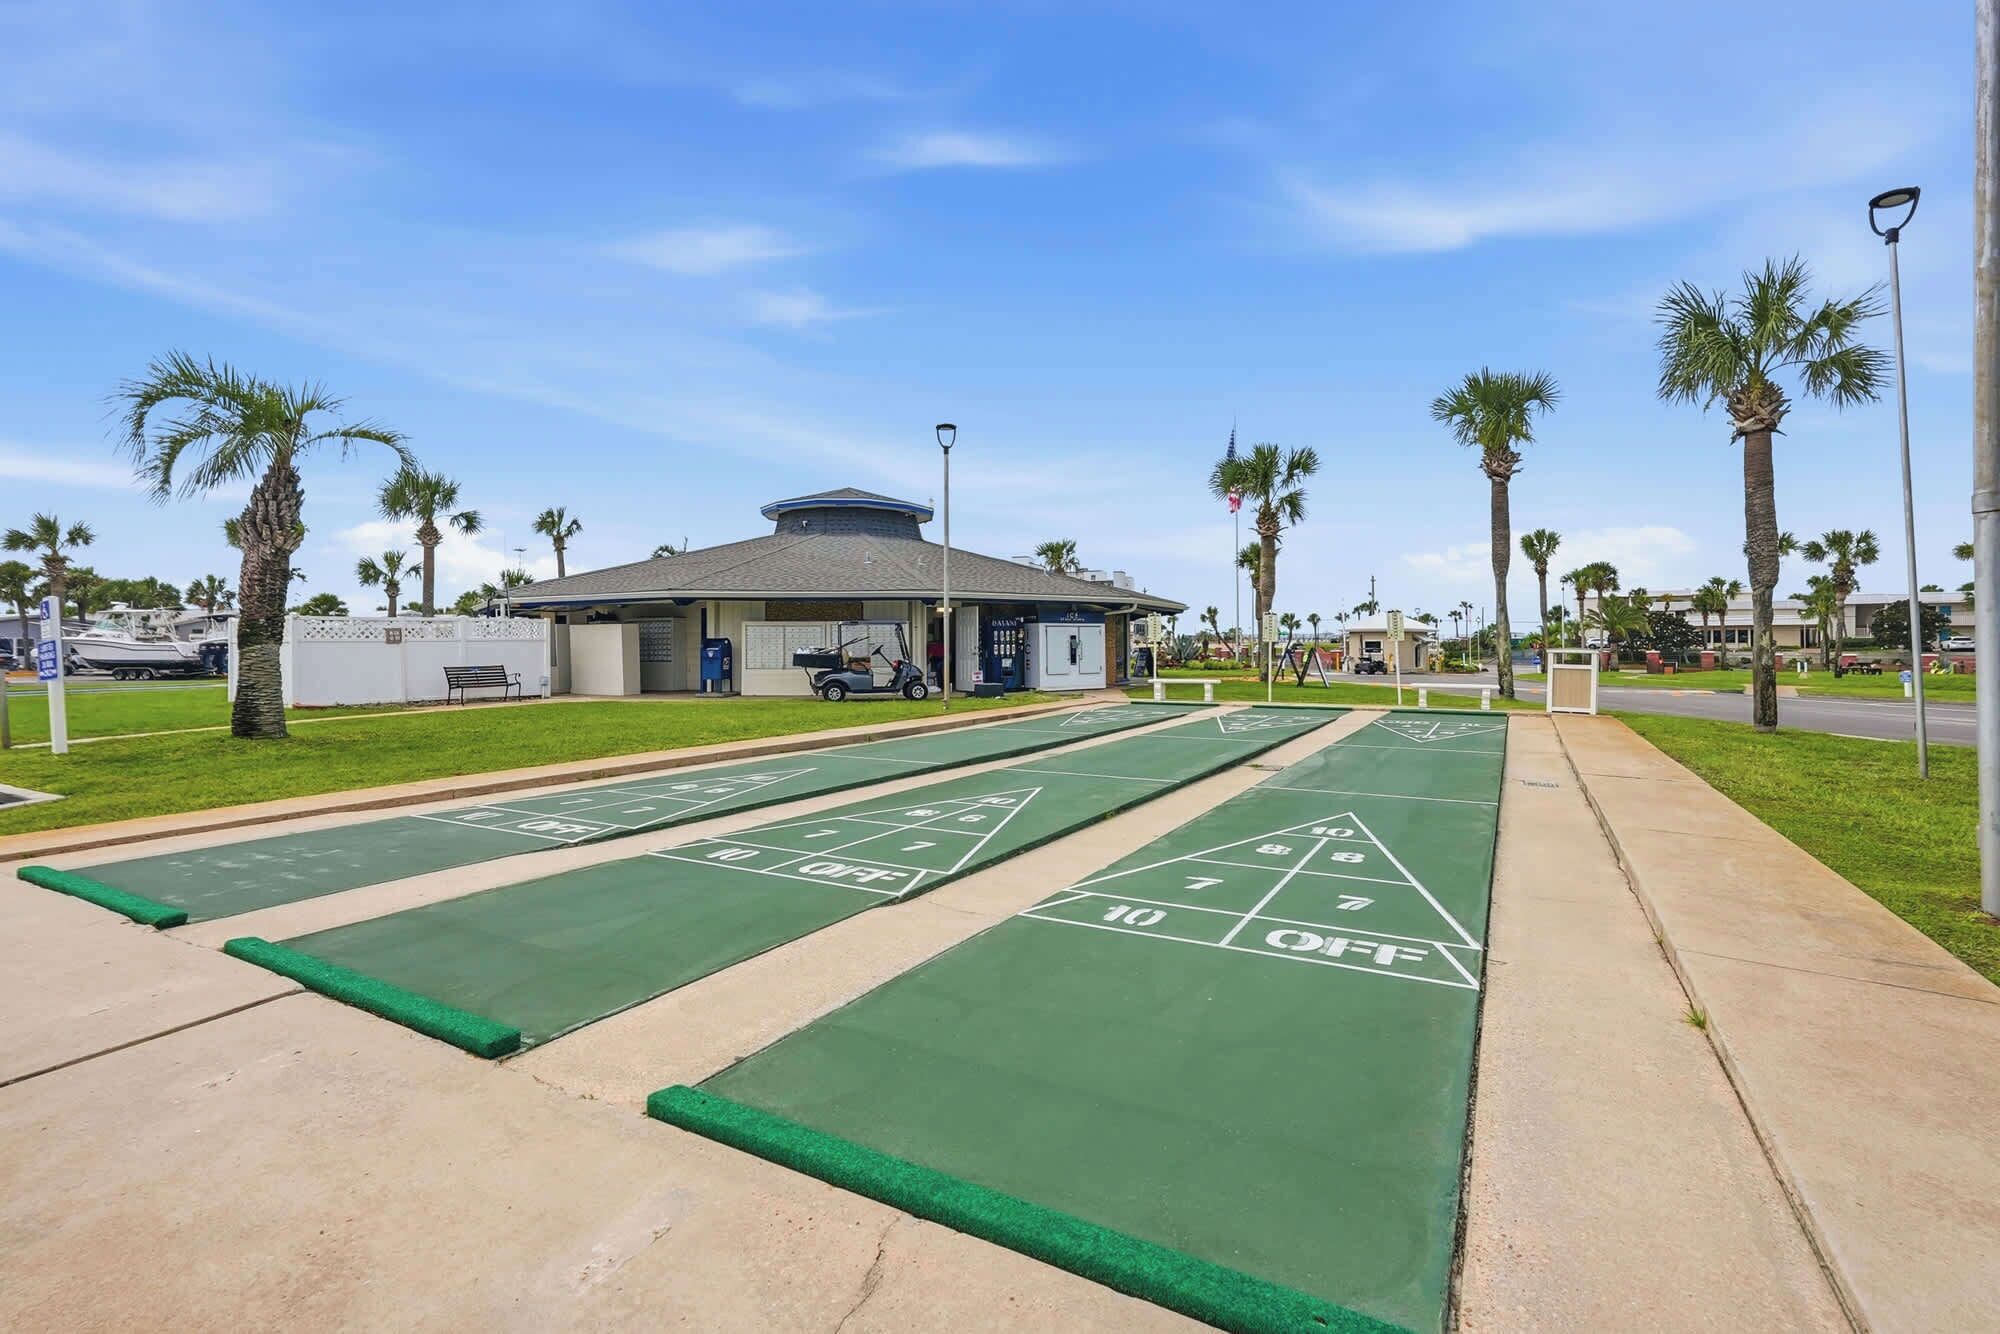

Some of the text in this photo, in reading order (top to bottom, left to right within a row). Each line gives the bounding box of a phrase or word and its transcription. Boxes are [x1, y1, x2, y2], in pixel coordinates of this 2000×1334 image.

[621, 806, 657, 814] 7
[804, 829, 841, 839] 7
[1310, 826, 1355, 838] 10
[900, 840, 937, 852] 7
[1255, 843, 1293, 856] 8
[706, 847, 761, 862] 10
[1330, 851, 1366, 864] 8
[798, 861, 910, 883] OFF
[1183, 876, 1225, 890] 7
[1335, 894, 1376, 912] 7
[1103, 904, 1168, 926] 10
[1265, 929, 1430, 966] OFF
